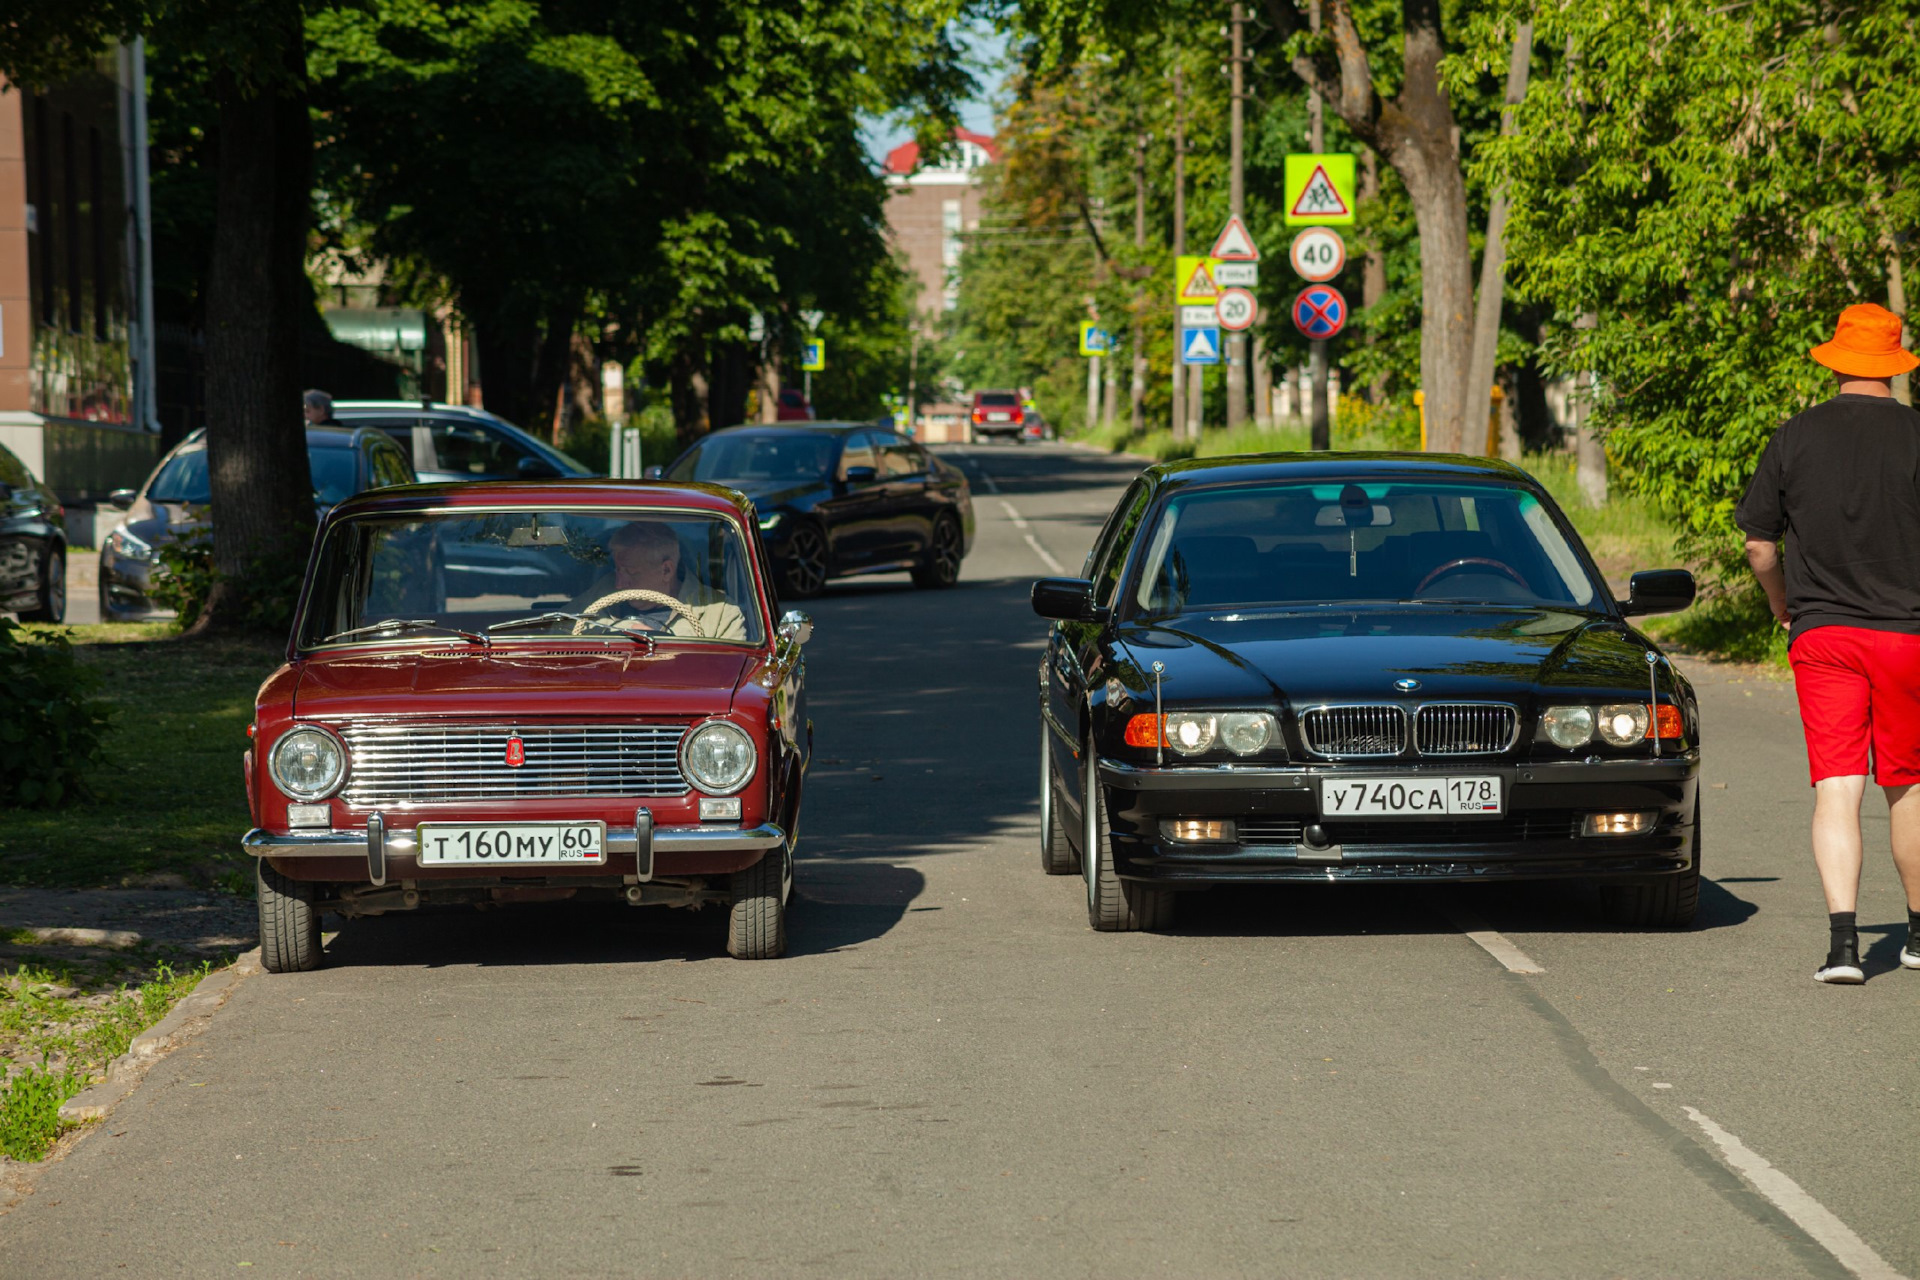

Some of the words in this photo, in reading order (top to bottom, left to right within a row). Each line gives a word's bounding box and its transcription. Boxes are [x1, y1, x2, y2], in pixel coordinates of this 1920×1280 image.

[1303, 243, 1333, 265] 40
[1226, 301, 1246, 318] 20
[1450, 780, 1491, 801] 178
[1460, 802, 1482, 810] RUS
[562, 828, 592, 849] 60
[560, 850, 583, 858] RUS
